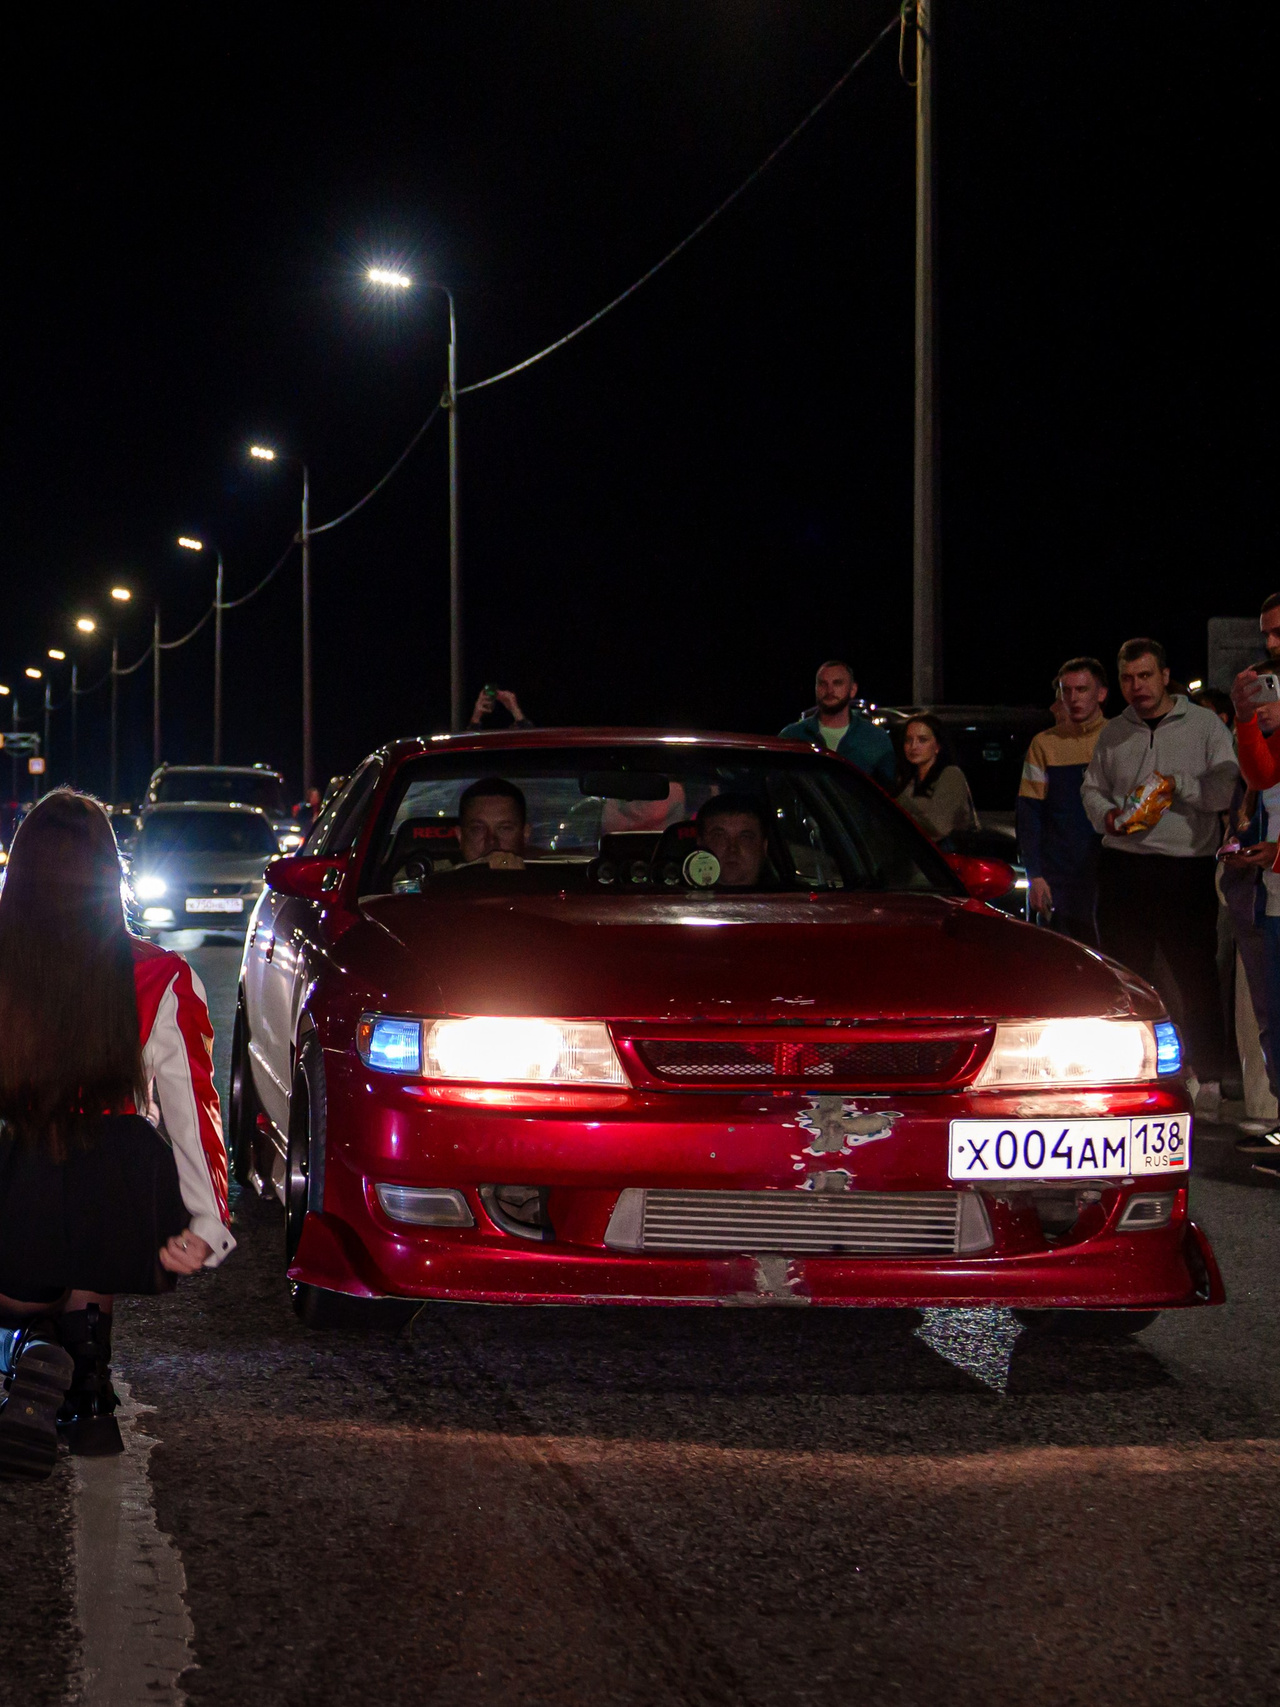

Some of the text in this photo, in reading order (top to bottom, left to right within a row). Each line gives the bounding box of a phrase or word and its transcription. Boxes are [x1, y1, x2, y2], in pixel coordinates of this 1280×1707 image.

[413, 826, 457, 839] RECA
[1135, 1122, 1180, 1154] 138
[1145, 1155, 1168, 1167] RUS
